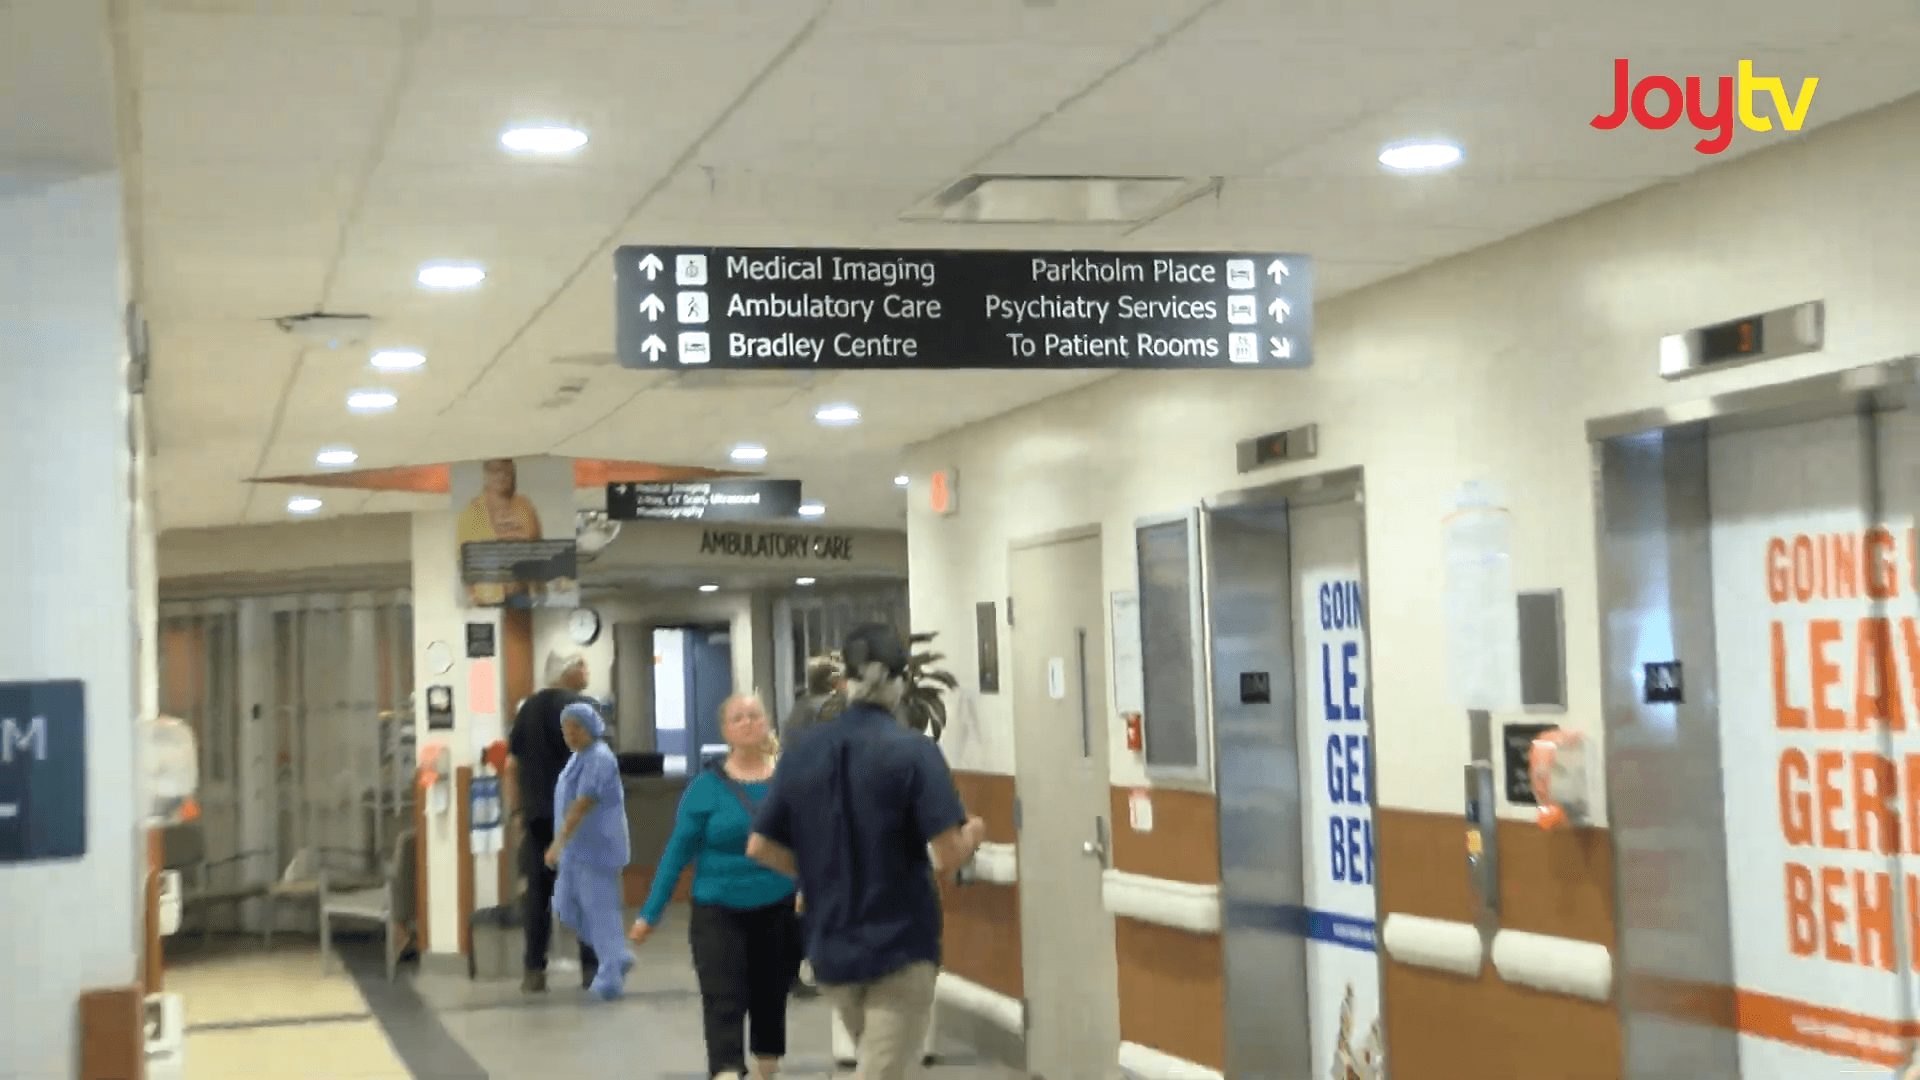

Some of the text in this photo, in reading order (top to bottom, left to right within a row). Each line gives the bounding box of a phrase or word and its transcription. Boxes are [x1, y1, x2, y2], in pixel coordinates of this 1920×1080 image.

[726, 255, 936, 287] Medical Imaging
[1031, 257, 1217, 283] Parkholm Place
[726, 292, 942, 323] Ambulatory Care
[985, 294, 1218, 324] Psychiatry Services
[728, 332, 918, 363] Bradley Centre
[1005, 332, 1220, 358] To Patient Rooms
[700, 530, 854, 561] AMBULATORY CARE
[1765, 526, 1900, 604] GOING
[1321, 641, 1366, 722] LE
